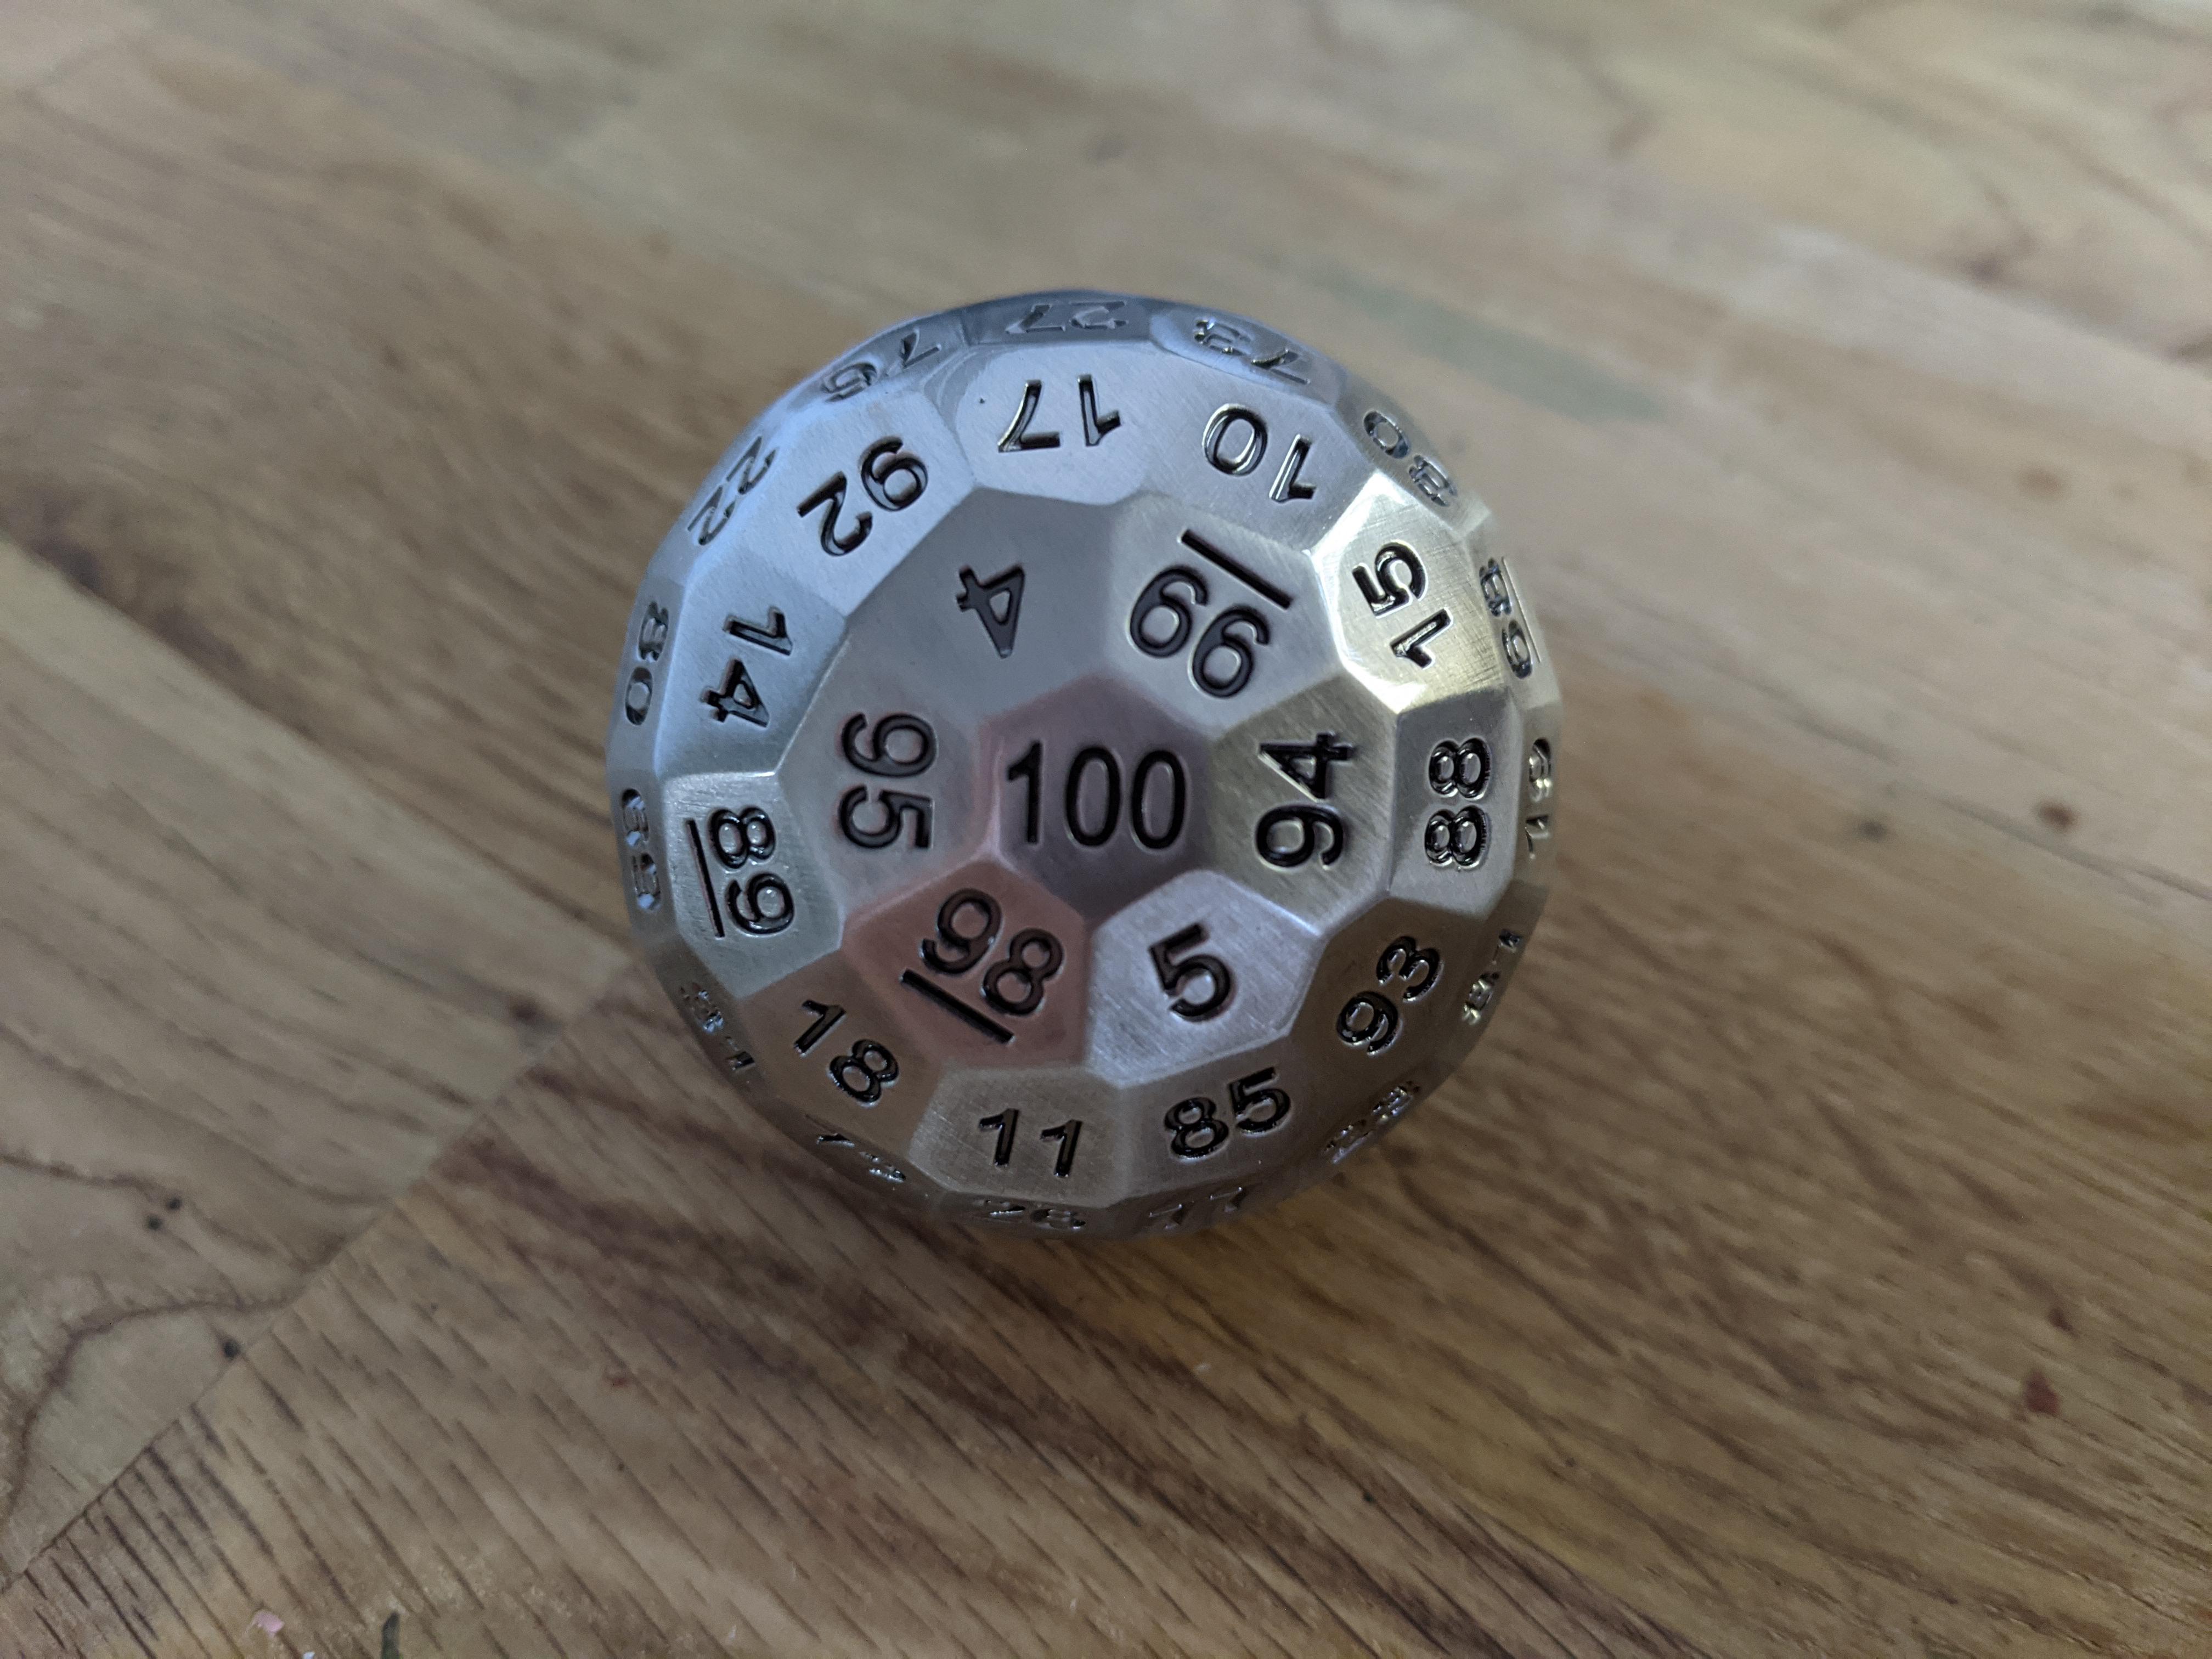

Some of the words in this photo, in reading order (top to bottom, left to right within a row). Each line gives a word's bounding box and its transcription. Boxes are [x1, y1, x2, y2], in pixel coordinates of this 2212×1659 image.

[821, 328, 943, 403] 76
[1006, 300, 1128, 334] 27
[1193, 316, 1311, 385] 73
[997, 374, 1121, 453] 17
[1201, 403, 1317, 503] 10
[686, 436, 776, 546] 22
[797, 436, 929, 556] 92
[955, 563, 1025, 659] 4
[1126, 563, 1272, 699] 99
[1351, 540, 1454, 669] 15
[624, 601, 669, 726] 80
[699, 606, 794, 728] 14
[837, 712, 938, 850] 95
[1007, 740, 1188, 851] 100
[1254, 732, 1357, 872] 94
[1424, 737, 1492, 871] 88
[708, 806, 795, 935] 89
[919, 888, 1064, 1019] 98
[1147, 924, 1233, 1023] 5
[1335, 936, 1443, 1057] 93
[794, 998, 900, 1107] 18
[978, 1108, 1084, 1178] 11
[1163, 1066, 1291, 1163] 85
